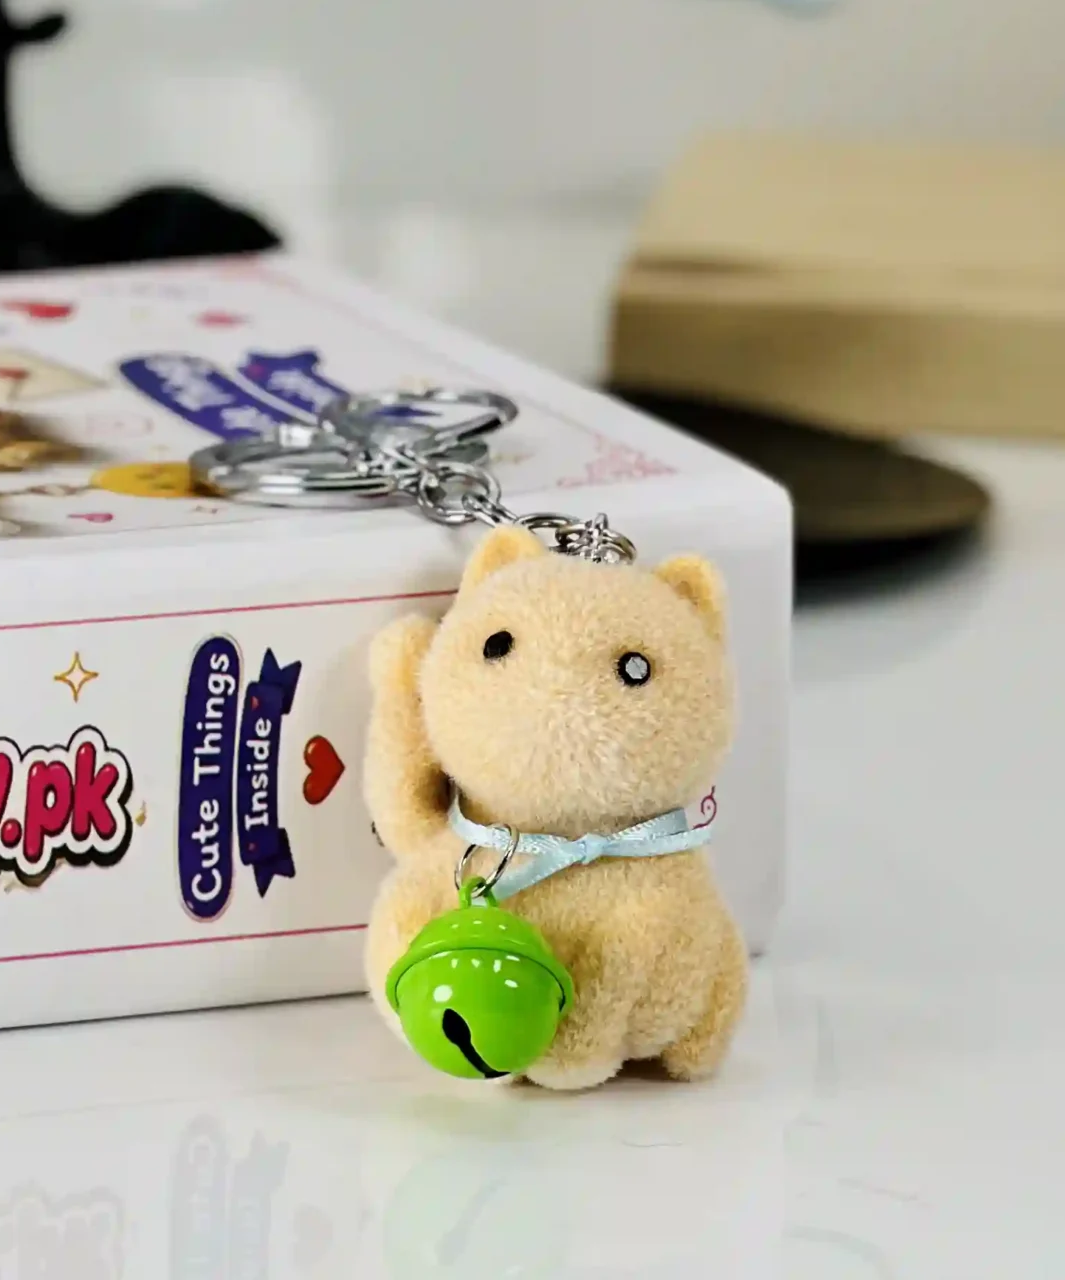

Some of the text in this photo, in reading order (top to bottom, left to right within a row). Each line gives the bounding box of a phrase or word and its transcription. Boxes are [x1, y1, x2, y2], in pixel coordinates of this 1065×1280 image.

[190, 651, 236, 903] Cute Things
[243, 717, 273, 831] Inside
